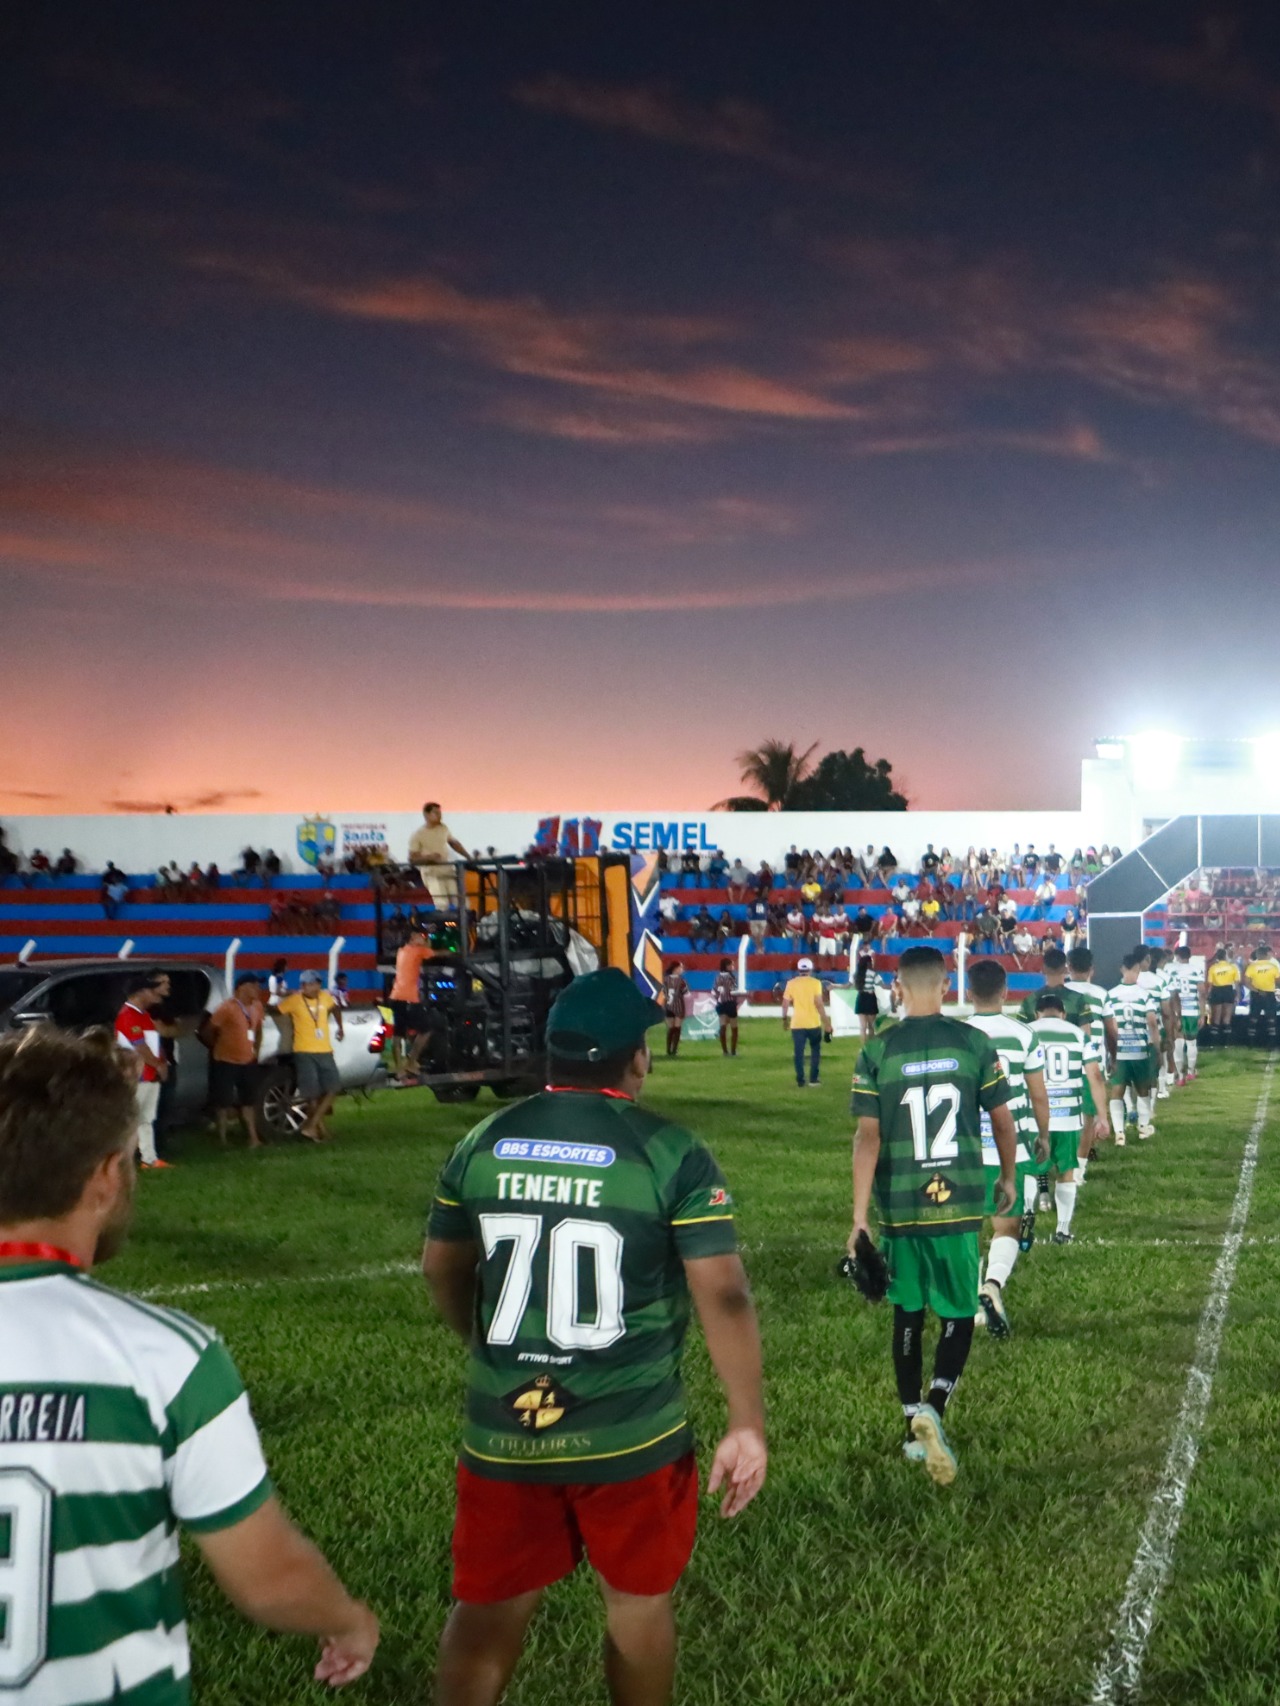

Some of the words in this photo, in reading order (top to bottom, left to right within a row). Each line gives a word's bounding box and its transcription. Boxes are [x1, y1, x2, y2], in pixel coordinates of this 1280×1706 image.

[612, 822, 717, 850] SEMEL
[900, 1082, 961, 1160] 12
[500, 1142, 529, 1155] BBS
[531, 1144, 607, 1163] ESPORTES
[496, 1172, 604, 1208] TENENTE
[479, 1213, 627, 1350] 70
